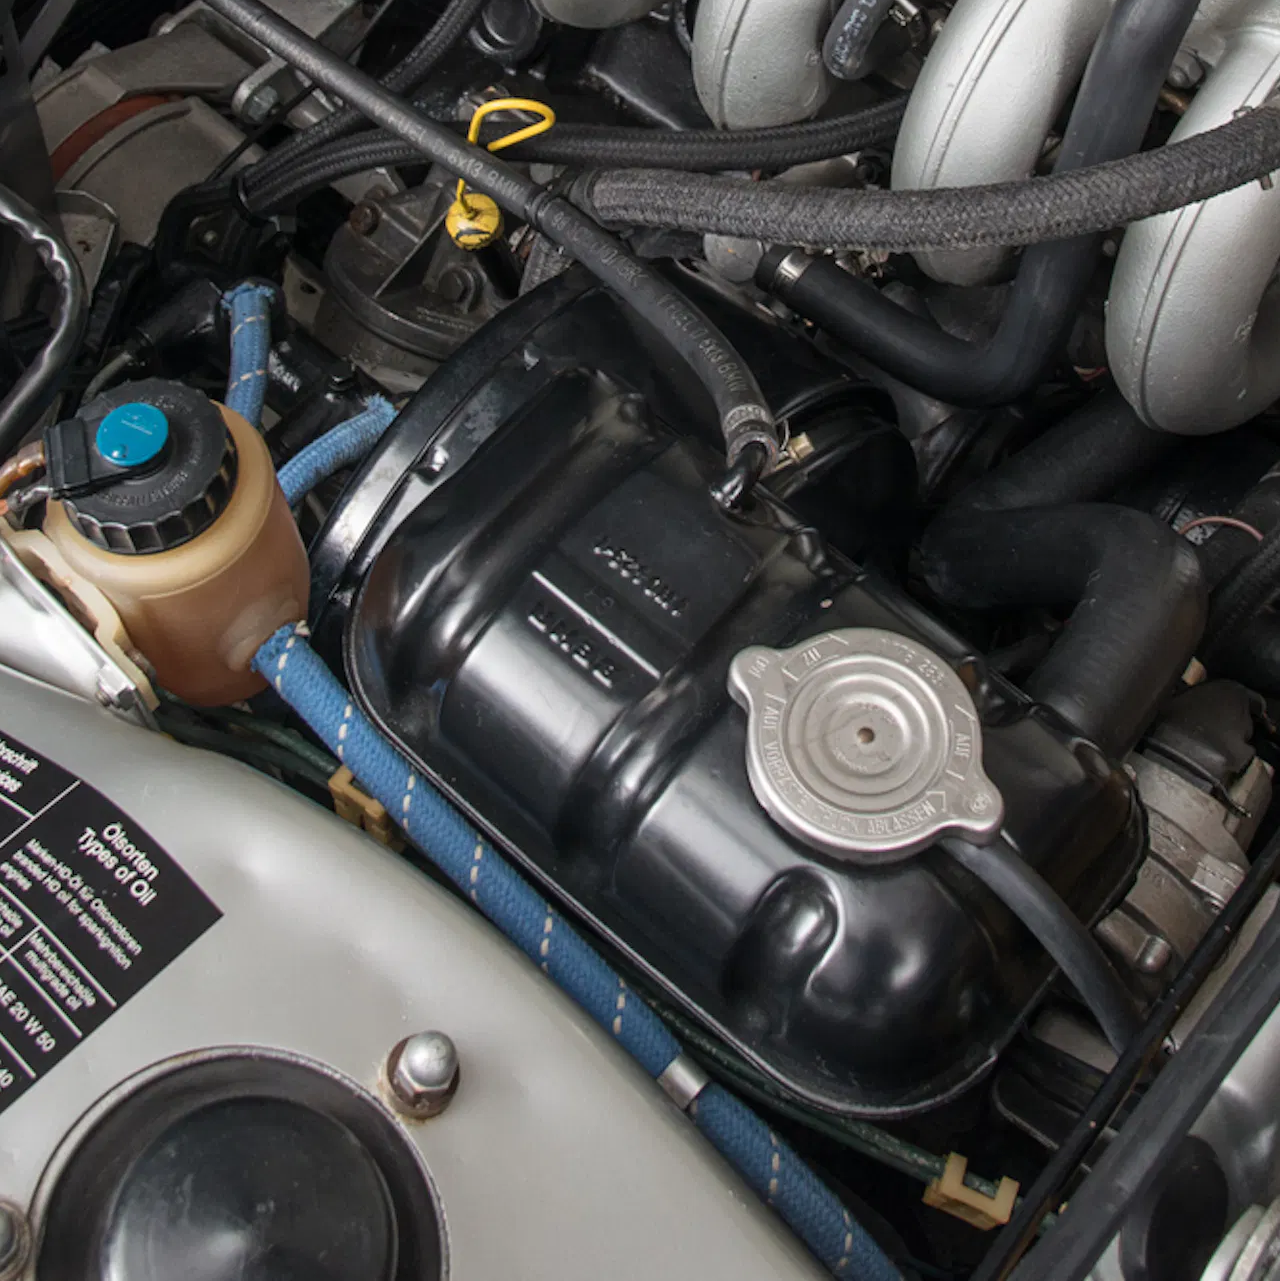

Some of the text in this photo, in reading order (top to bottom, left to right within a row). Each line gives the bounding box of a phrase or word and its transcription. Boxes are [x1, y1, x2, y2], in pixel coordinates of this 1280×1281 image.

[486, 168, 522, 202] BMW
[801, 646, 822, 667] ZU
[954, 732, 972, 759] AUF
[866, 798, 938, 835] ABLASSEN
[77, 826, 158, 907] Types of Oil
[94, 822, 159, 882] Ölsorten
[12, 849, 49, 881] branded
[41, 874, 62, 893] HD
[55, 890, 73, 904] oil
[66, 898, 84, 915] for
[25, 838, 143, 956] Marken-HD-Öl für Ottomotoren
[65, 995, 83, 1011] oil
[8, 1001, 30, 1022] 20
[24, 1015, 44, 1035] W
[35, 1030, 56, 1052] 50
